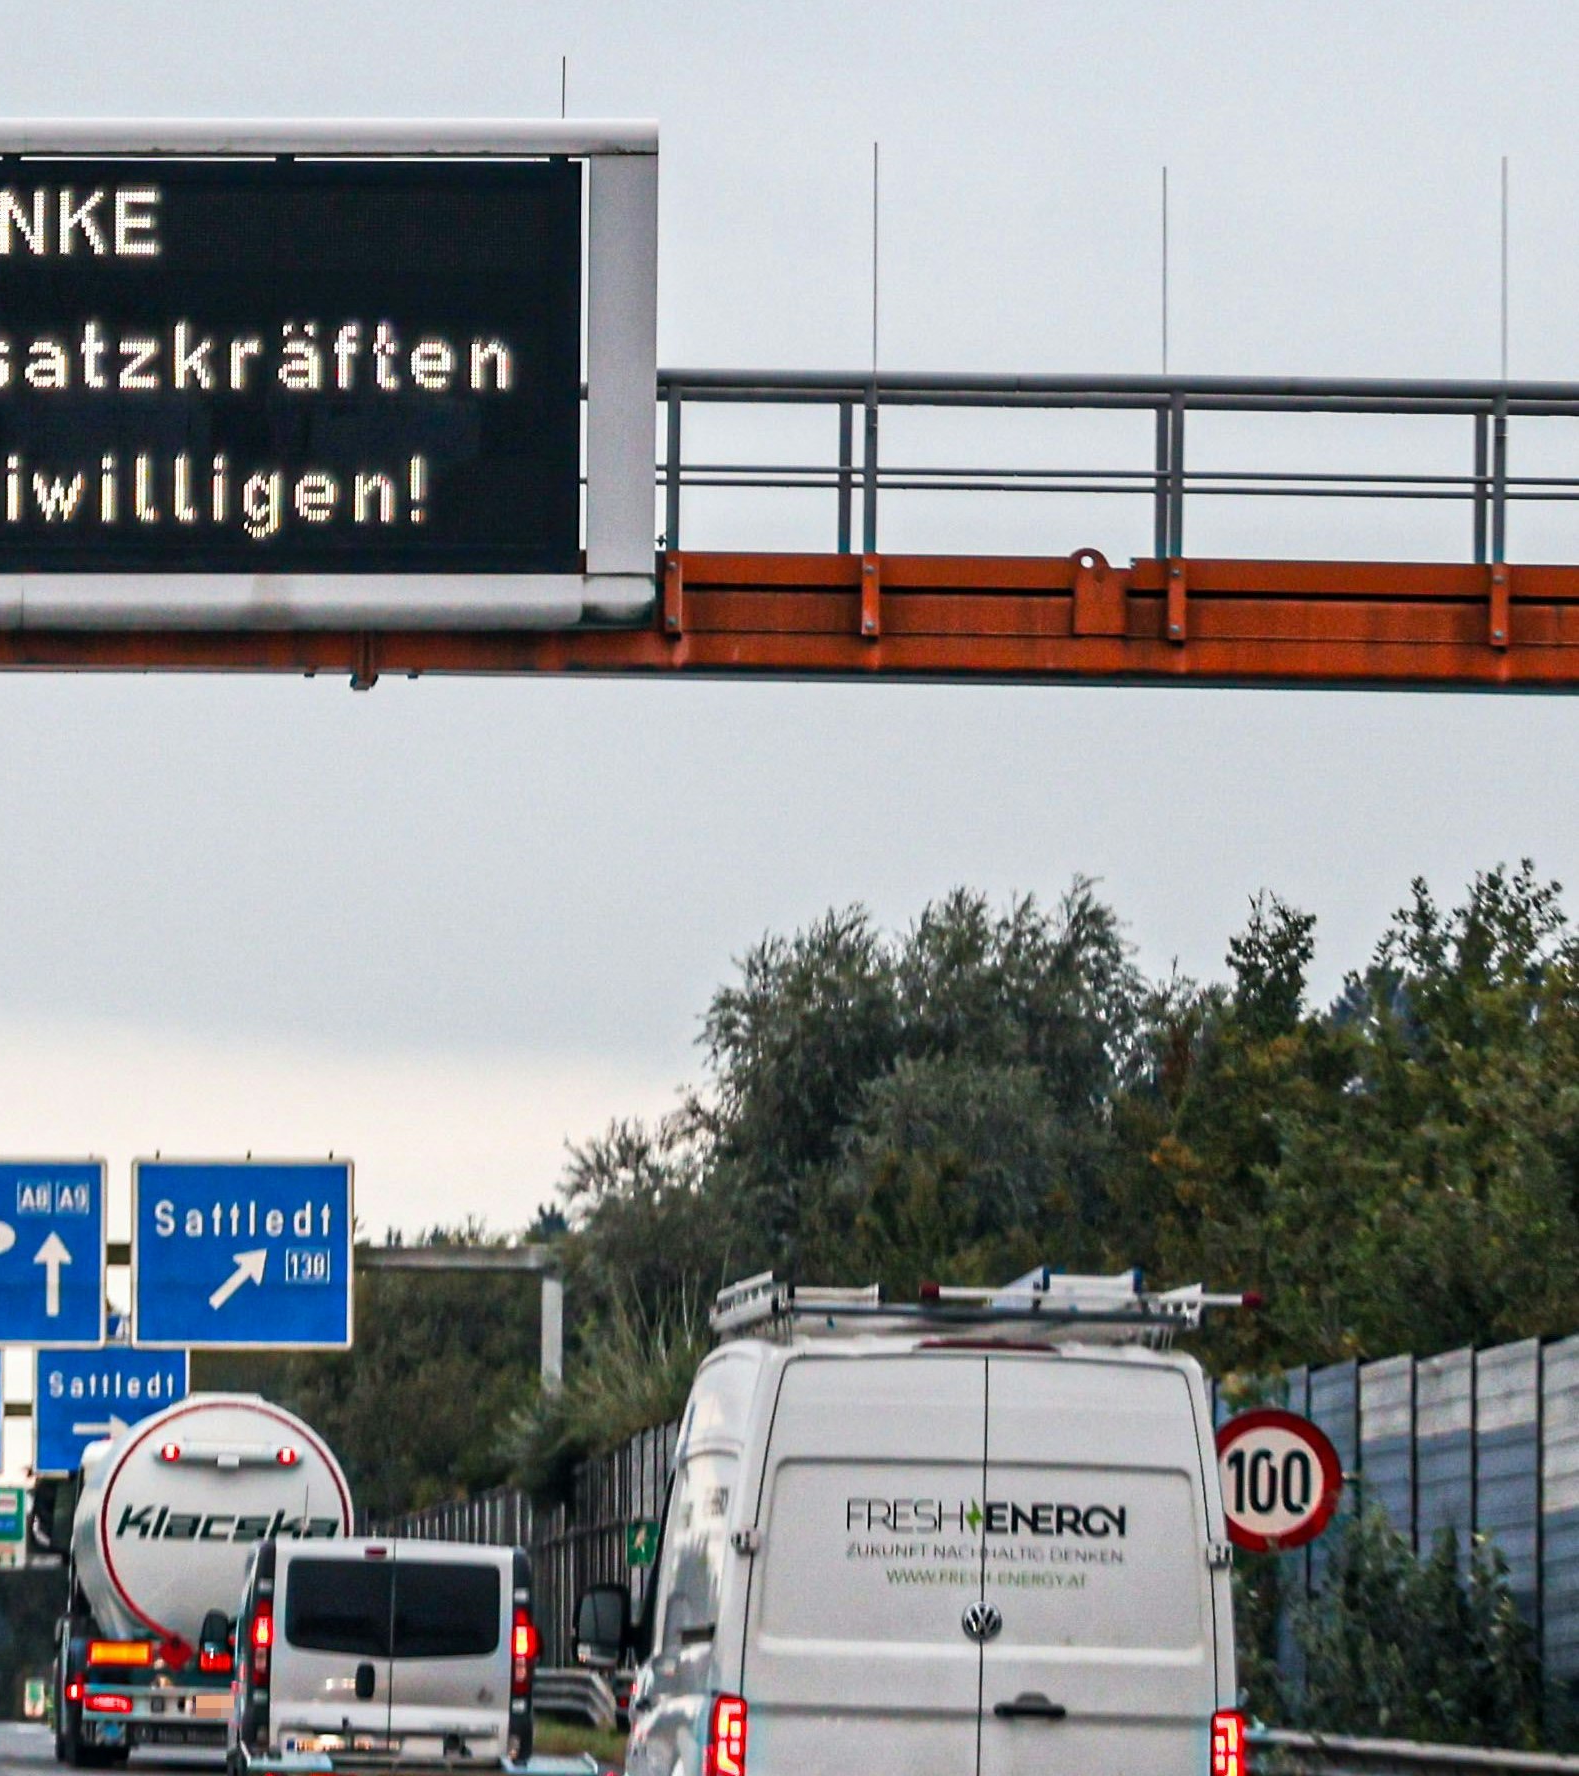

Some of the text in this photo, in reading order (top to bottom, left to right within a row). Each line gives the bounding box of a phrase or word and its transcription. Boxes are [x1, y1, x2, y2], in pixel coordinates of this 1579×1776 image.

[154, 1199, 331, 1238] Sattledt
[49, 1370, 174, 1399] Sattledt
[1227, 1448, 1311, 1516] 100
[114, 1502, 340, 1543] Klacska
[846, 1498, 1126, 1539] FRESH ENERGY
[845, 1541, 1124, 1564] ZUKUNFT NACHHALTIG DENKEN
